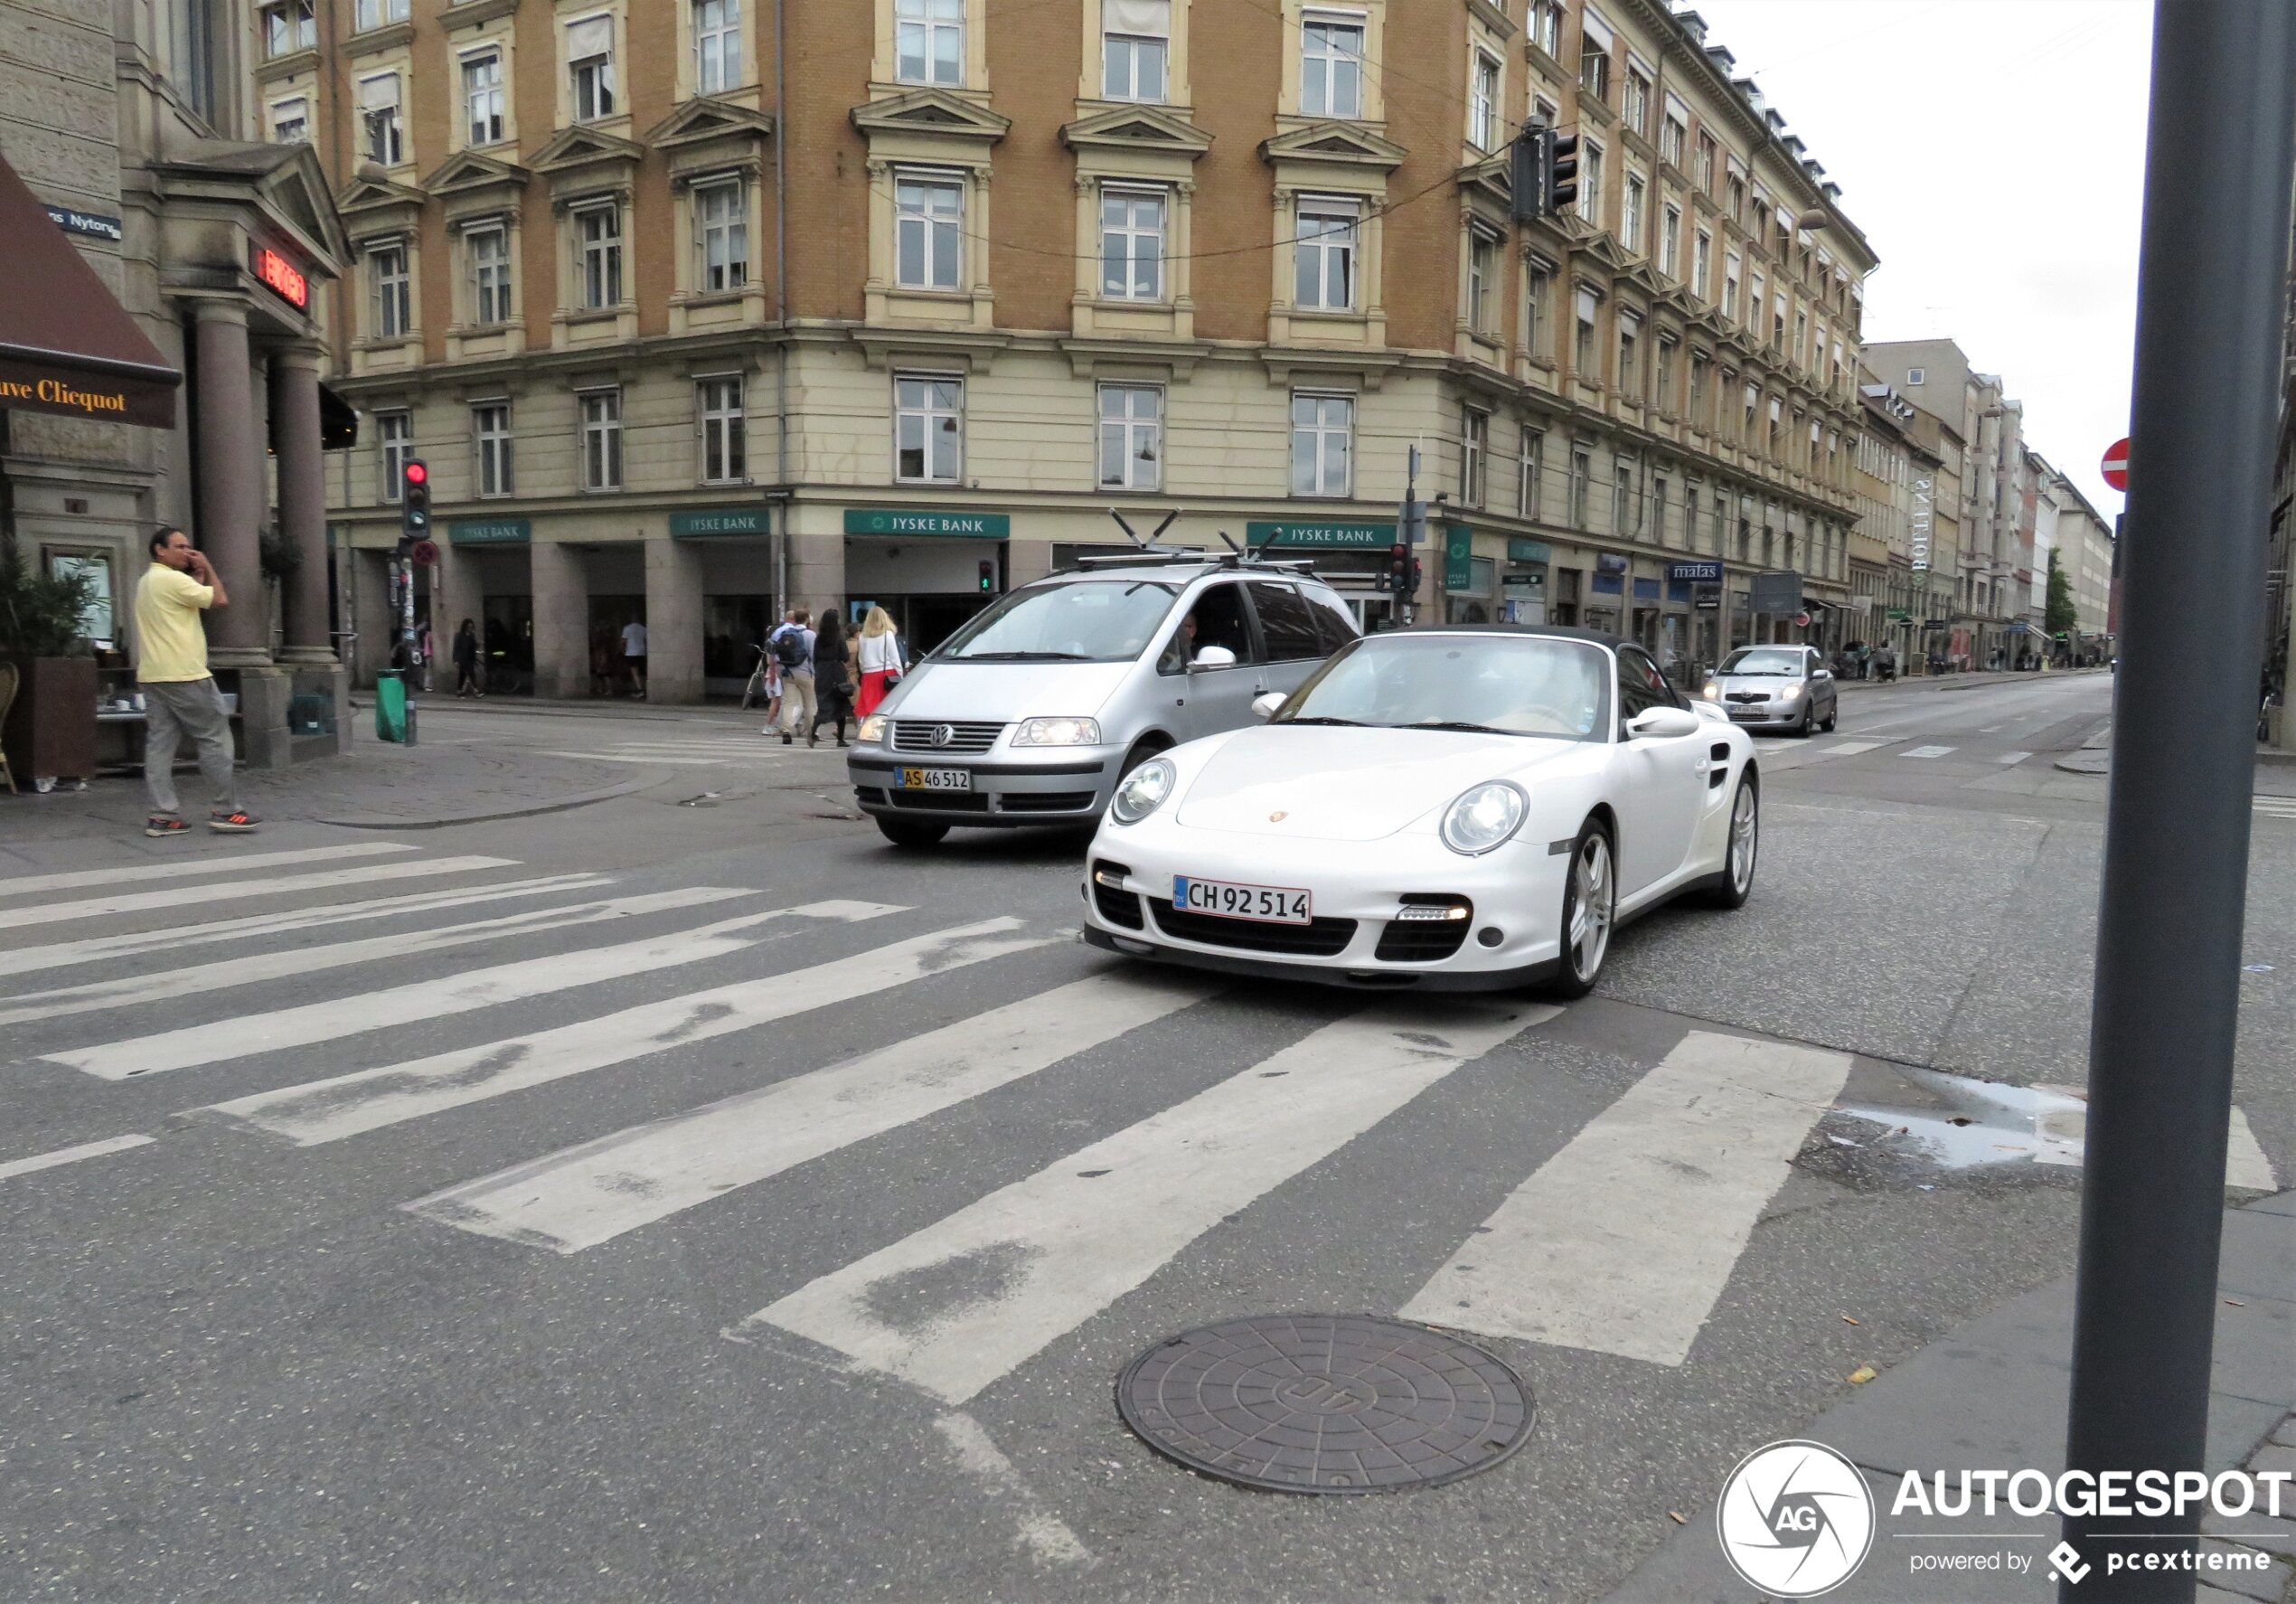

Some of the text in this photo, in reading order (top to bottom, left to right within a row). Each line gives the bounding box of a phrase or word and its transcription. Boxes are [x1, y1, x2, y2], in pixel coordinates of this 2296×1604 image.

[71, 213, 114, 233] Nytorv
[37, 380, 126, 412] Clicquot
[723, 517, 757, 529] BANK
[892, 518, 983, 532] JYSKE BANK
[491, 526, 519, 536] BANK
[1291, 529, 1374, 542] JYSKE BANK
[1673, 563, 1716, 578] matas
[905, 770, 968, 788] AS 46 512
[1189, 882, 1307, 919] CH 92 514
